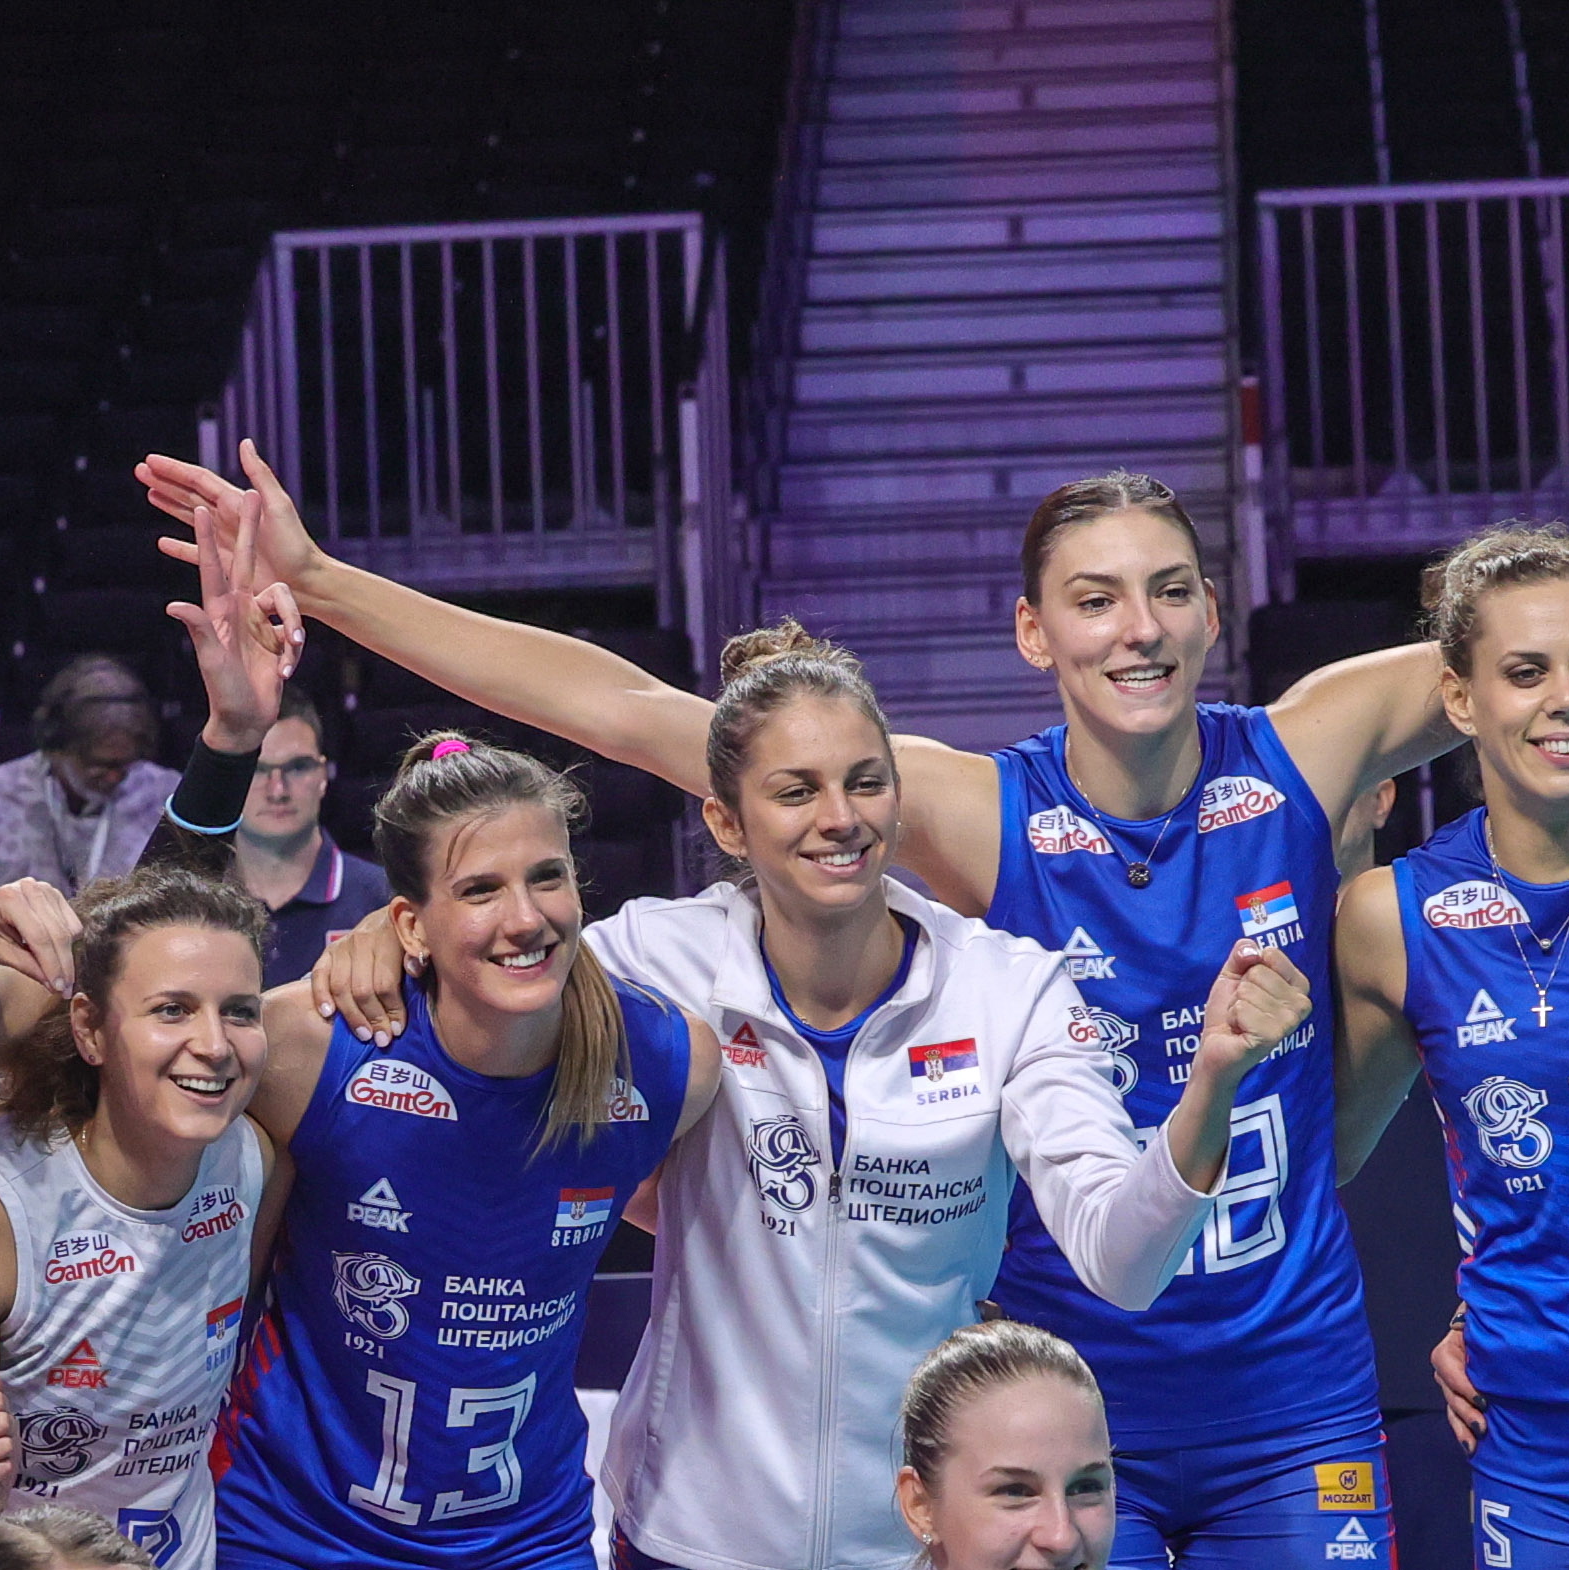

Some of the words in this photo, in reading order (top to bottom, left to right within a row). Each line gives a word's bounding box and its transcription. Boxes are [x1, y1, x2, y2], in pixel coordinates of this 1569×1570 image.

[1201, 777, 1253, 808] 百岁山
[1197, 789, 1279, 833] Ganten
[1442, 884, 1500, 907] 百岁山
[1428, 899, 1522, 929] Ganten
[1456, 1016, 1518, 1049] PEAK
[369, 1062, 431, 1091] 百岁山
[350, 1076, 451, 1120] Ganten
[916, 1084, 983, 1106] SERBIA
[853, 1154, 931, 1176] БАНКА
[849, 1175, 985, 1202] ПОШТАНСКА
[1504, 1172, 1547, 1196] 1921
[346, 1201, 412, 1233] PEAK
[848, 1193, 988, 1226] ШТЕДИОНИЦА
[550, 1223, 605, 1248] SERBIA
[760, 1210, 797, 1238] 1921
[53, 1233, 110, 1258] 百岁山
[45, 1248, 136, 1285] Ganten
[443, 1275, 526, 1298] БАНКА
[440, 1290, 576, 1323] ПОШТАНСКА
[437, 1303, 577, 1351] ШТЕДИОНИЦА
[344, 1332, 386, 1360] 1921
[46, 1367, 111, 1390] PEAK
[128, 1405, 198, 1431] БАНКА
[347, 1368, 538, 1527] 13
[13, 1473, 59, 1499] 1921
[1322, 1492, 1372, 1505] MOZZART
[1480, 1498, 1512, 1569] 5
[1325, 1541, 1378, 1561] PEAK
